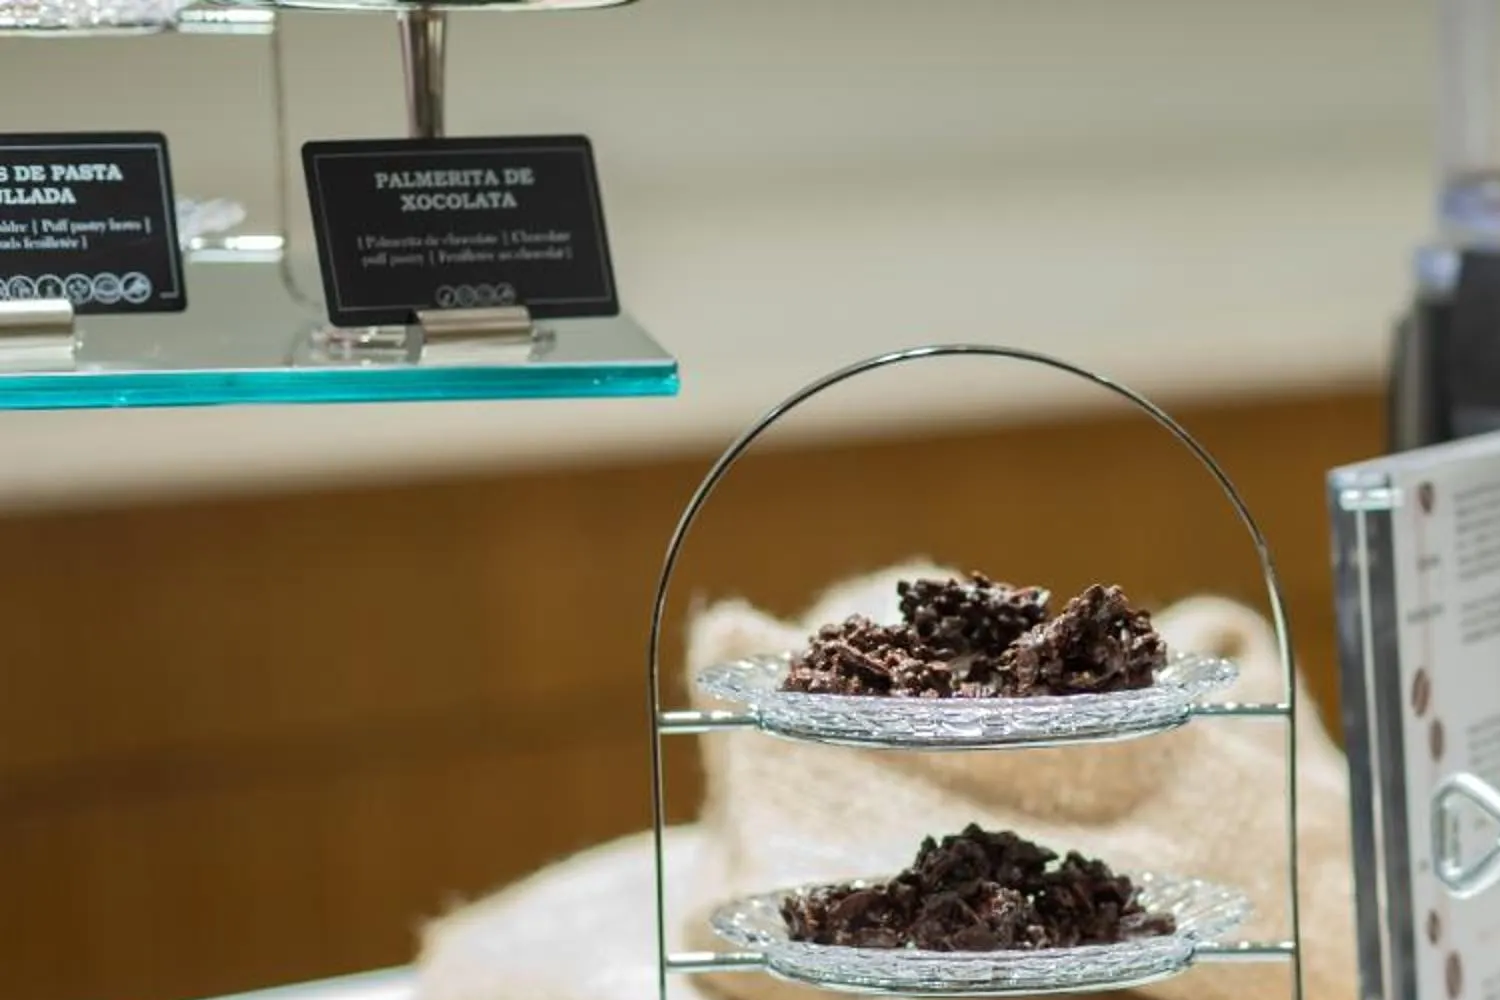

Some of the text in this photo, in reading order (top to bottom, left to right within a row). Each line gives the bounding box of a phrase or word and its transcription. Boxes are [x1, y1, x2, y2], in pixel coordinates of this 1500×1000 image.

[13, 164, 46, 181] DE
[49, 163, 124, 181] PASTA
[374, 168, 535, 189] PALMERITA DE
[401, 192, 518, 212] XOCOLATA
